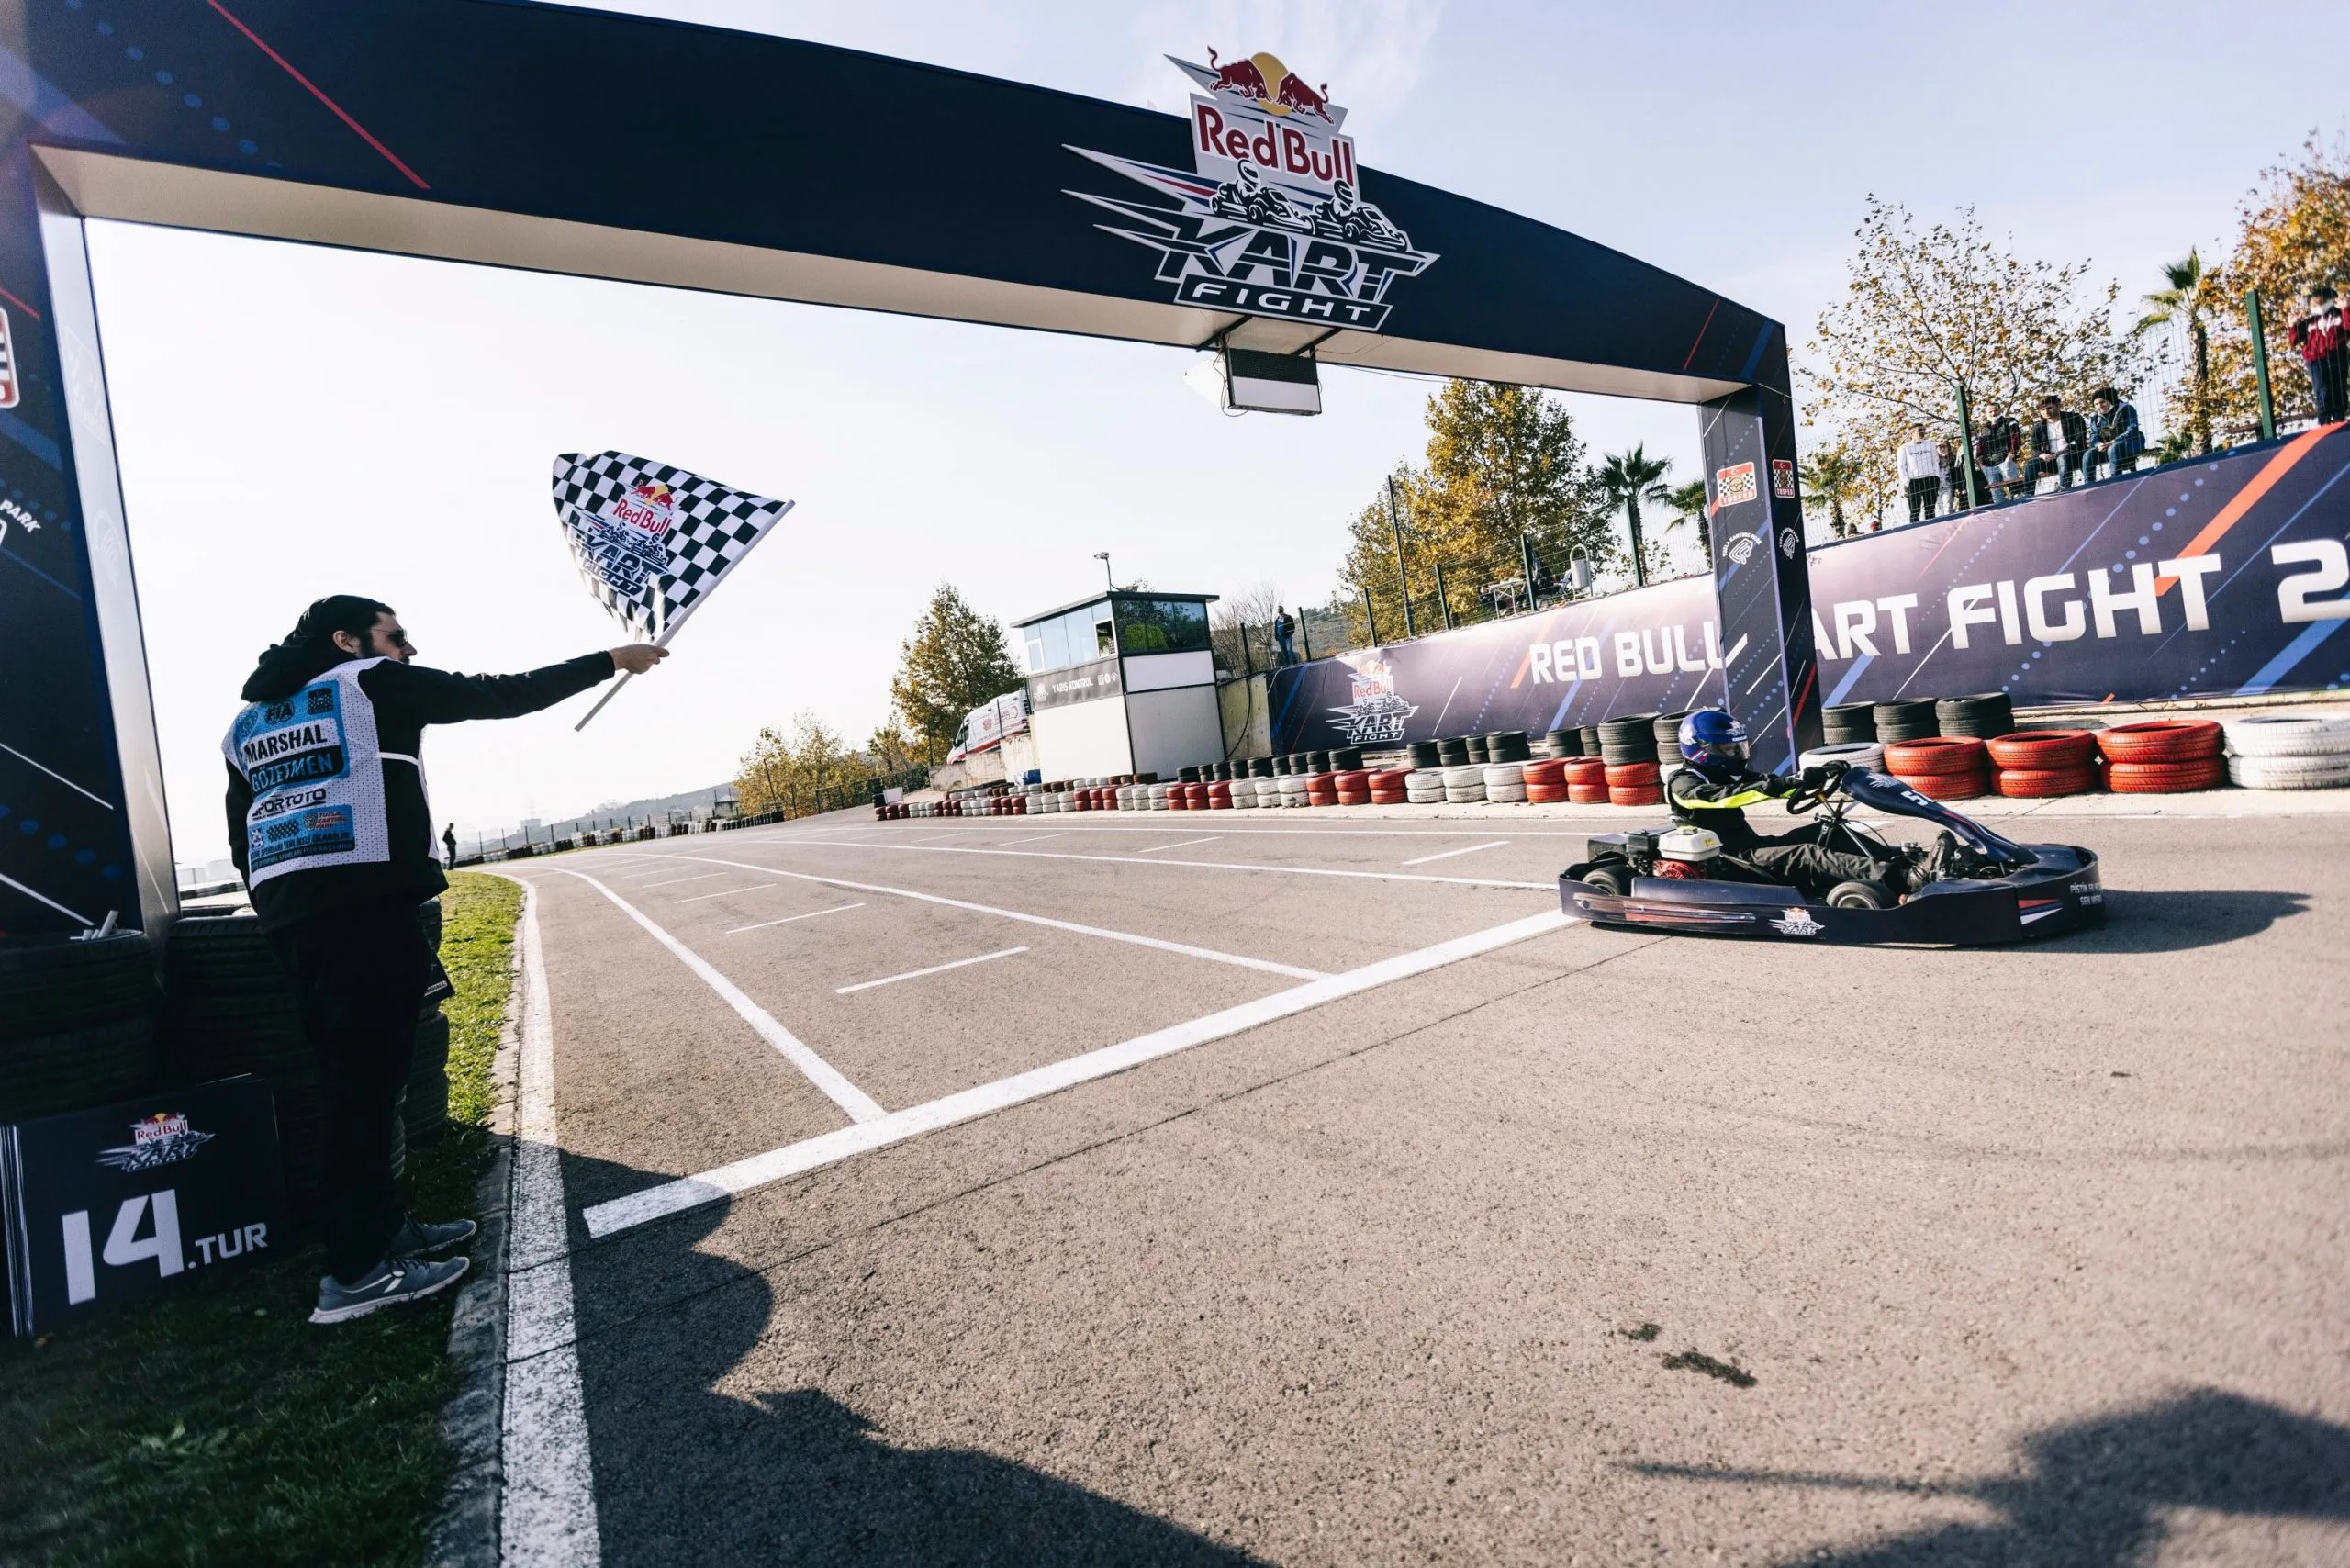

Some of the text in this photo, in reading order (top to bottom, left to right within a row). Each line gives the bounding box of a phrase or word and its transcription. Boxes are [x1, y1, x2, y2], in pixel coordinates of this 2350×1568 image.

[1197, 104, 1354, 186] Red Bull
[1158, 217, 1428, 303] KART
[1192, 283, 1371, 322] FIGHT
[0, 498, 42, 534] PARK
[613, 498, 672, 537] Red Bull
[578, 535, 666, 585] KART
[584, 561, 638, 590] FIGHT
[1529, 635, 1603, 685] RED
[1614, 621, 1724, 678] BULL
[1811, 593, 1918, 660] ART
[1946, 553, 2221, 650] FIGHT
[1354, 682, 1372, 698] Red
[244, 724, 327, 764] MARSHAL
[1347, 711, 1414, 738] KART
[1354, 732, 1398, 742] FIGHT
[252, 753, 333, 792] GÖZETMEN
[137, 1127, 162, 1140] Red
